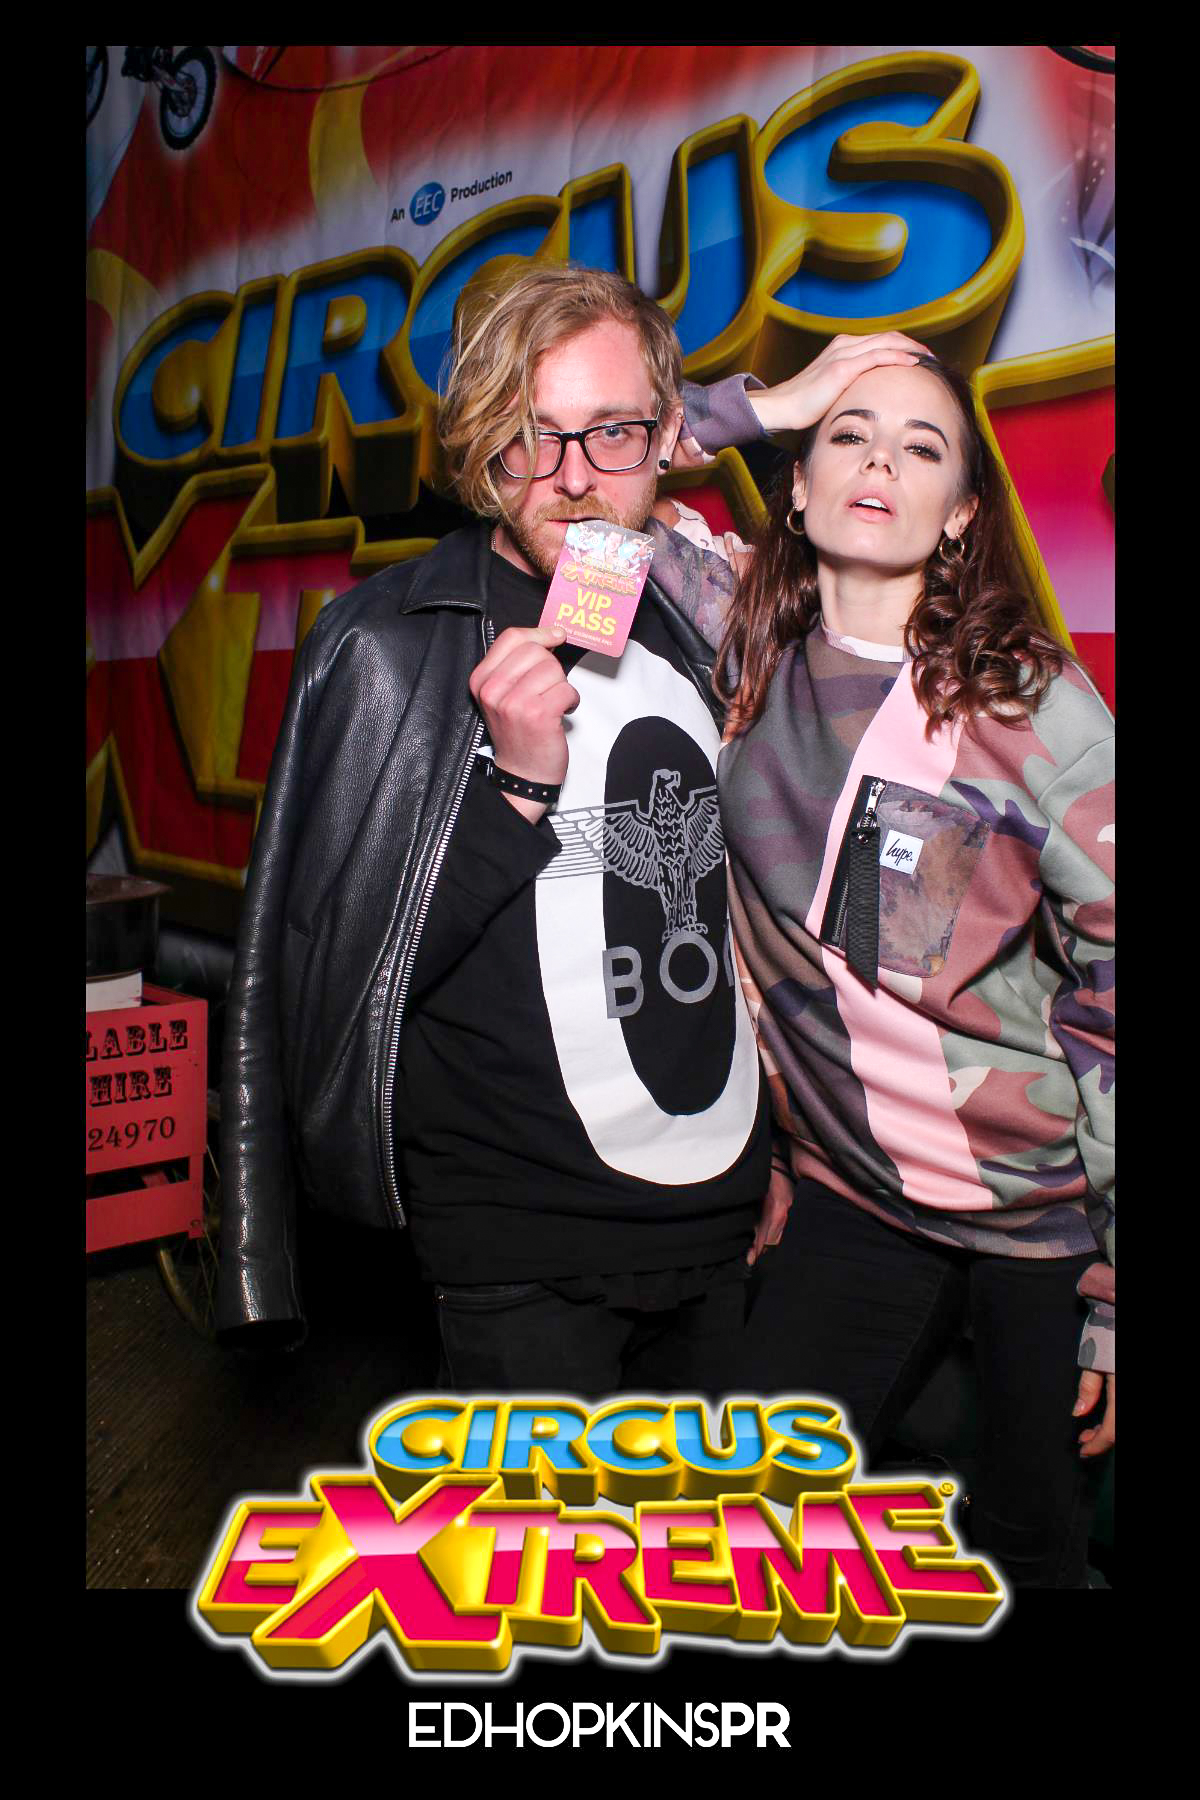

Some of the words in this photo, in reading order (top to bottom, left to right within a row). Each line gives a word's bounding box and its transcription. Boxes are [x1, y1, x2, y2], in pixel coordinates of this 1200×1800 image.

[390, 207, 405, 222] An
[414, 190, 443, 219] EEC
[450, 170, 513, 202] Production
[576, 587, 612, 612] VIP
[556, 603, 617, 636] PASS
[90, 1066, 172, 1107] HIRE
[88, 1116, 175, 1151] 24970
